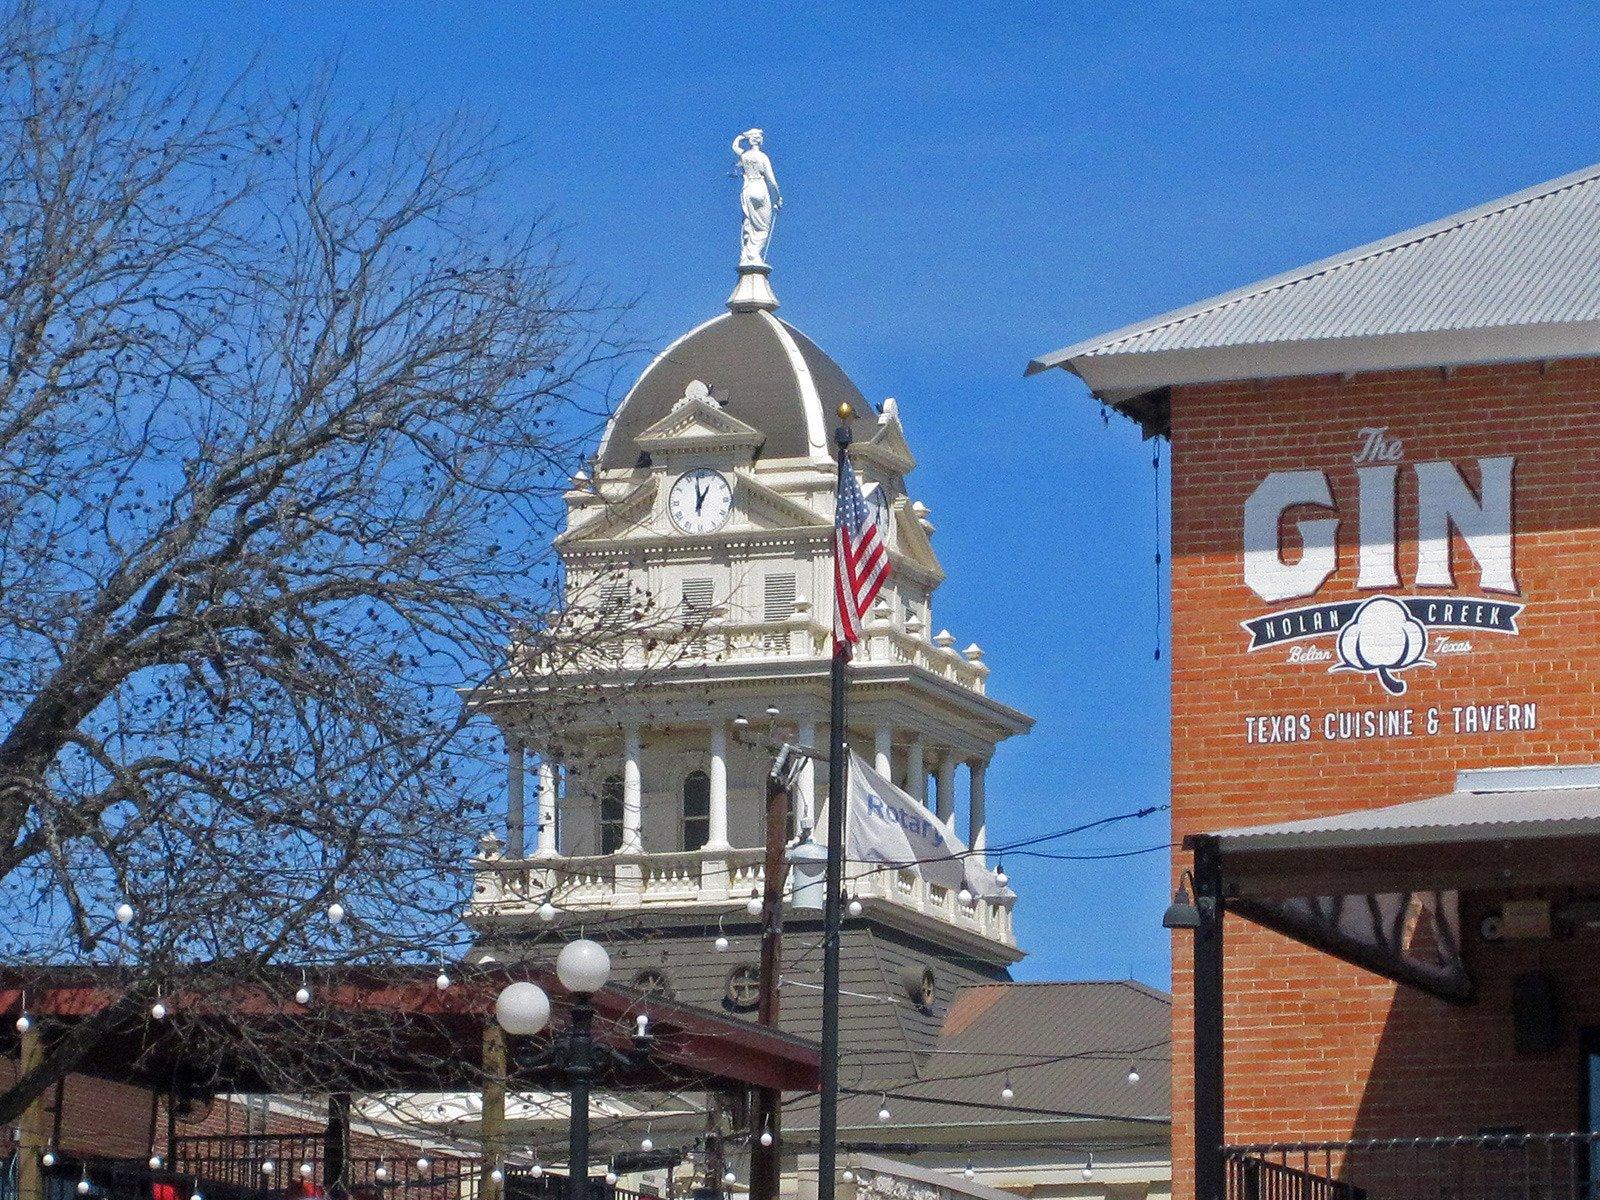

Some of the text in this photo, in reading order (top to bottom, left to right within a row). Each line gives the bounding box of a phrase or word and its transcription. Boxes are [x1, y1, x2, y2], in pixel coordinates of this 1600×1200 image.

[1354, 427, 1403, 462] The
[1244, 457, 1519, 603] GIN
[1265, 602, 1500, 639] NOLAN CREEK
[1286, 635, 1473, 663] Belton Texas
[1245, 702, 1538, 744] TEXAS CUISINE & TAVERN
